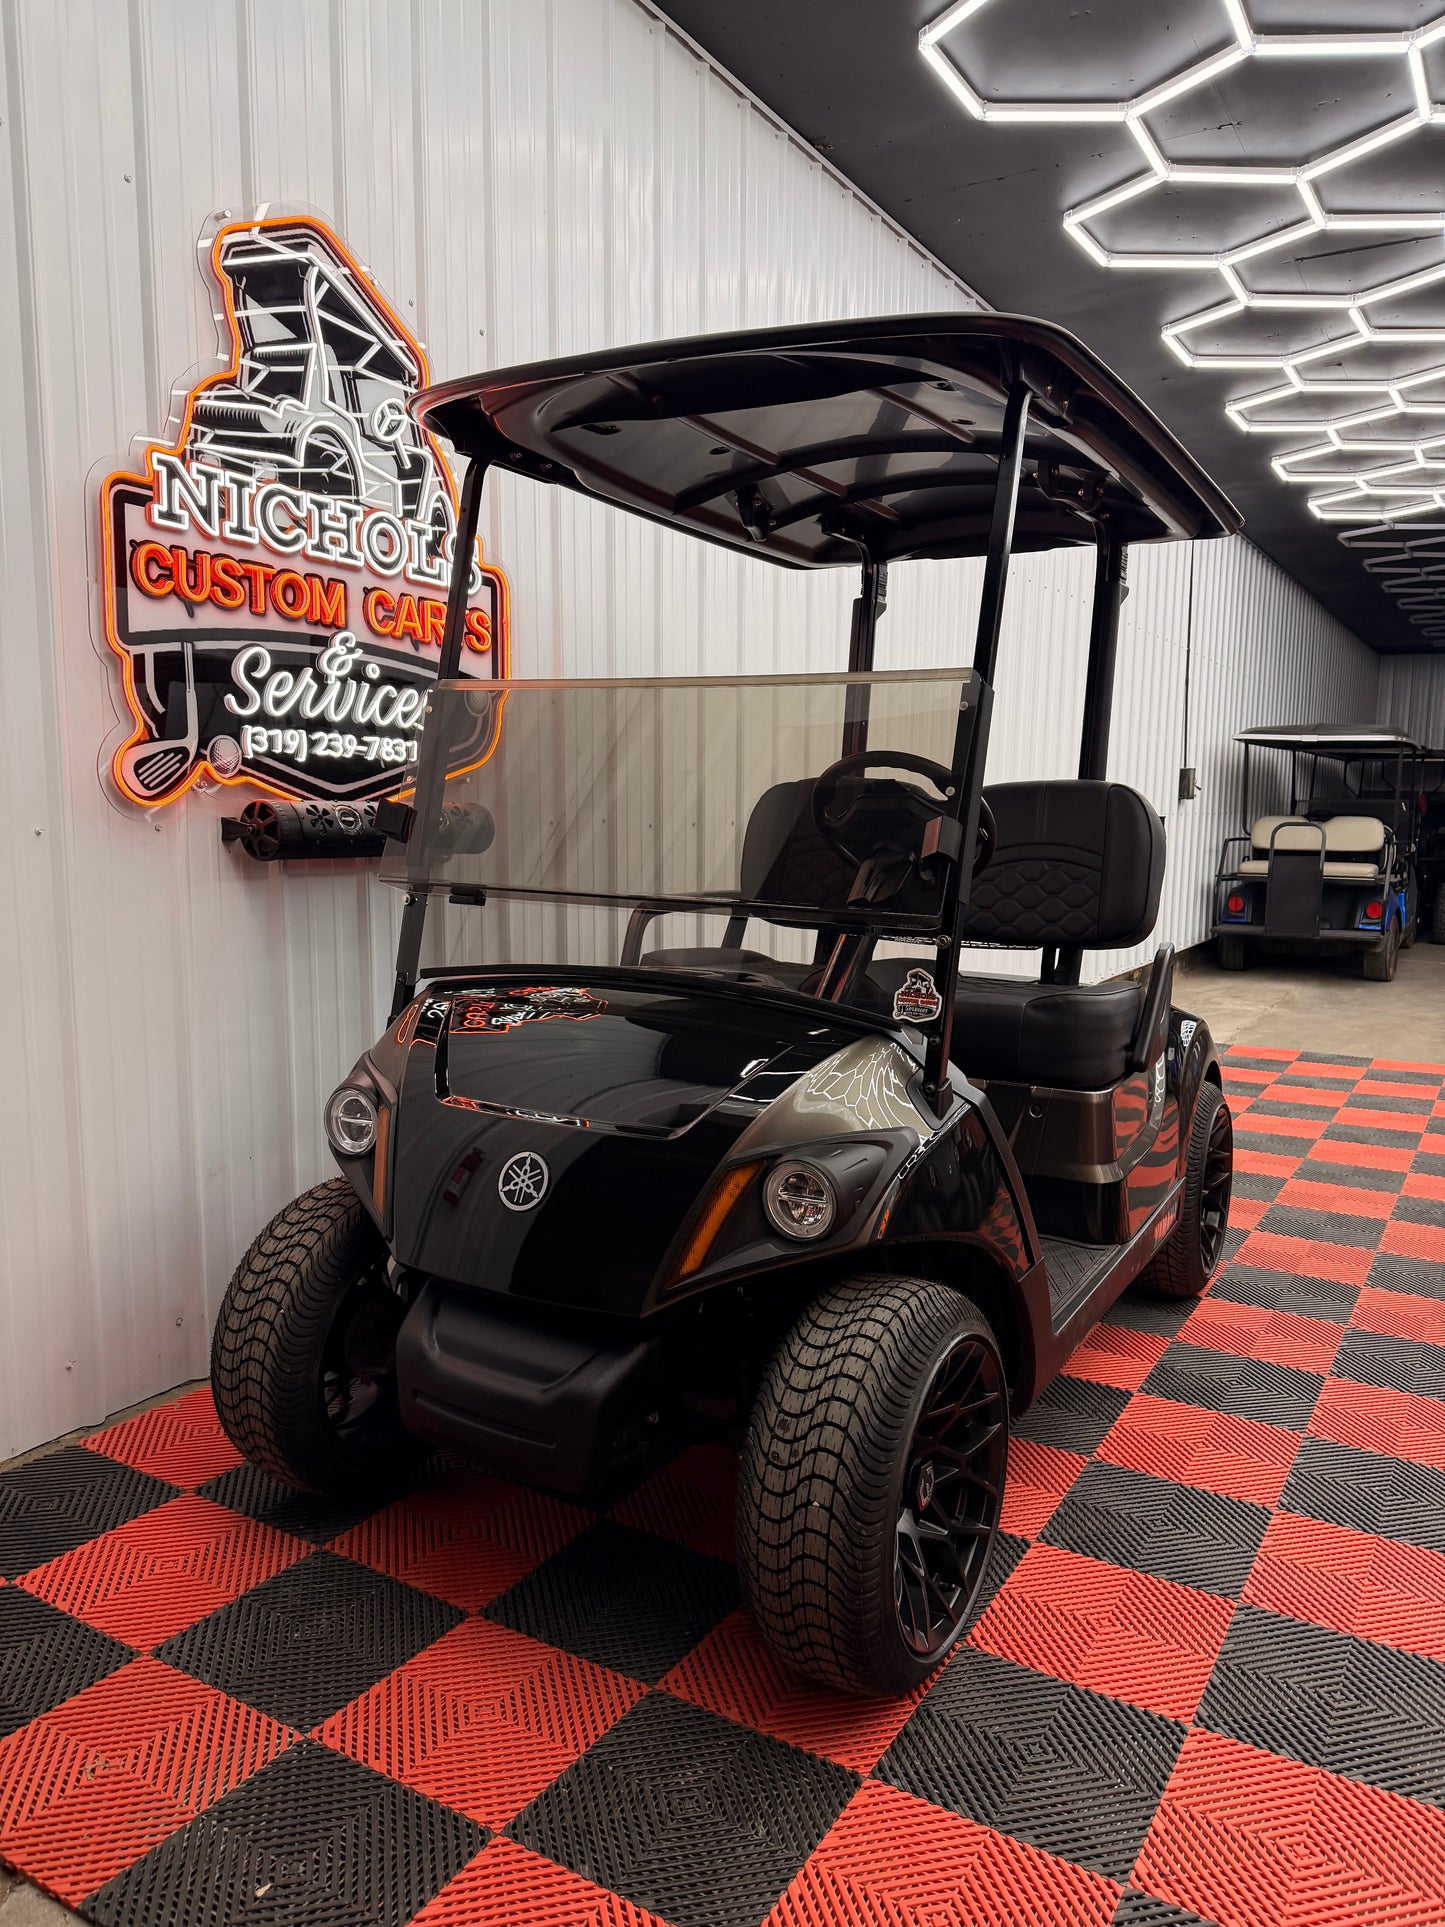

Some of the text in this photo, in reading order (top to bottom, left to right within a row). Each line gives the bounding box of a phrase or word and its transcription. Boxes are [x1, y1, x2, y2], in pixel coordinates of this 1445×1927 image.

[133, 541, 493, 653] CUSTOM CARS
[320, 631, 363, 683] &
[241, 725, 418, 762] (319) 239-7831
